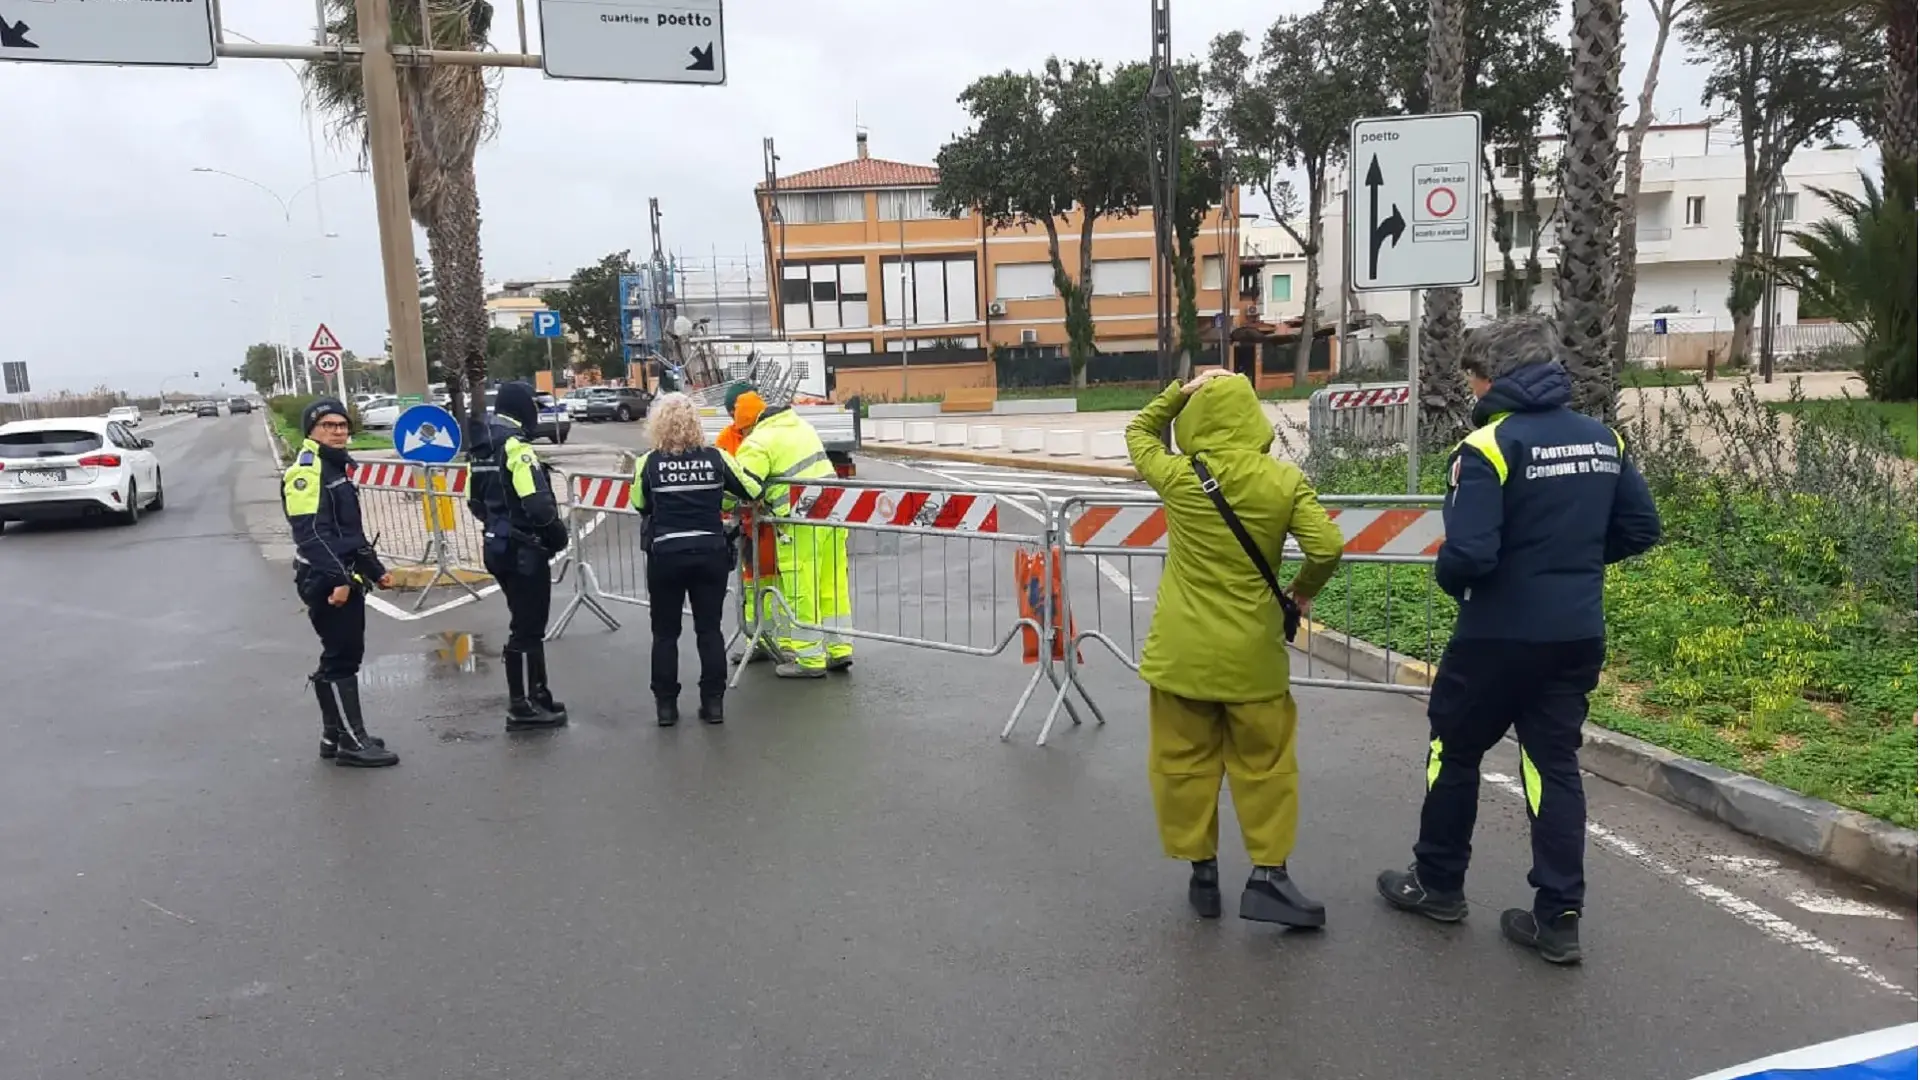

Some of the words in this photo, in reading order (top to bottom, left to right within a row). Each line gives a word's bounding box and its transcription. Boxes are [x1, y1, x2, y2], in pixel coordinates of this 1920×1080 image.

[599, 13, 649, 25] quartiere
[657, 13, 712, 27] poetto
[1360, 131, 1400, 144] poetto
[538, 314, 556, 335] P
[320, 357, 335, 369] 50
[1531, 443, 1596, 461] PROTEZIONE
[658, 460, 713, 471] POLIZIA
[1525, 461, 1577, 480] COMUNE
[1578, 461, 1590, 474] DI
[660, 471, 715, 483] LOCALE
